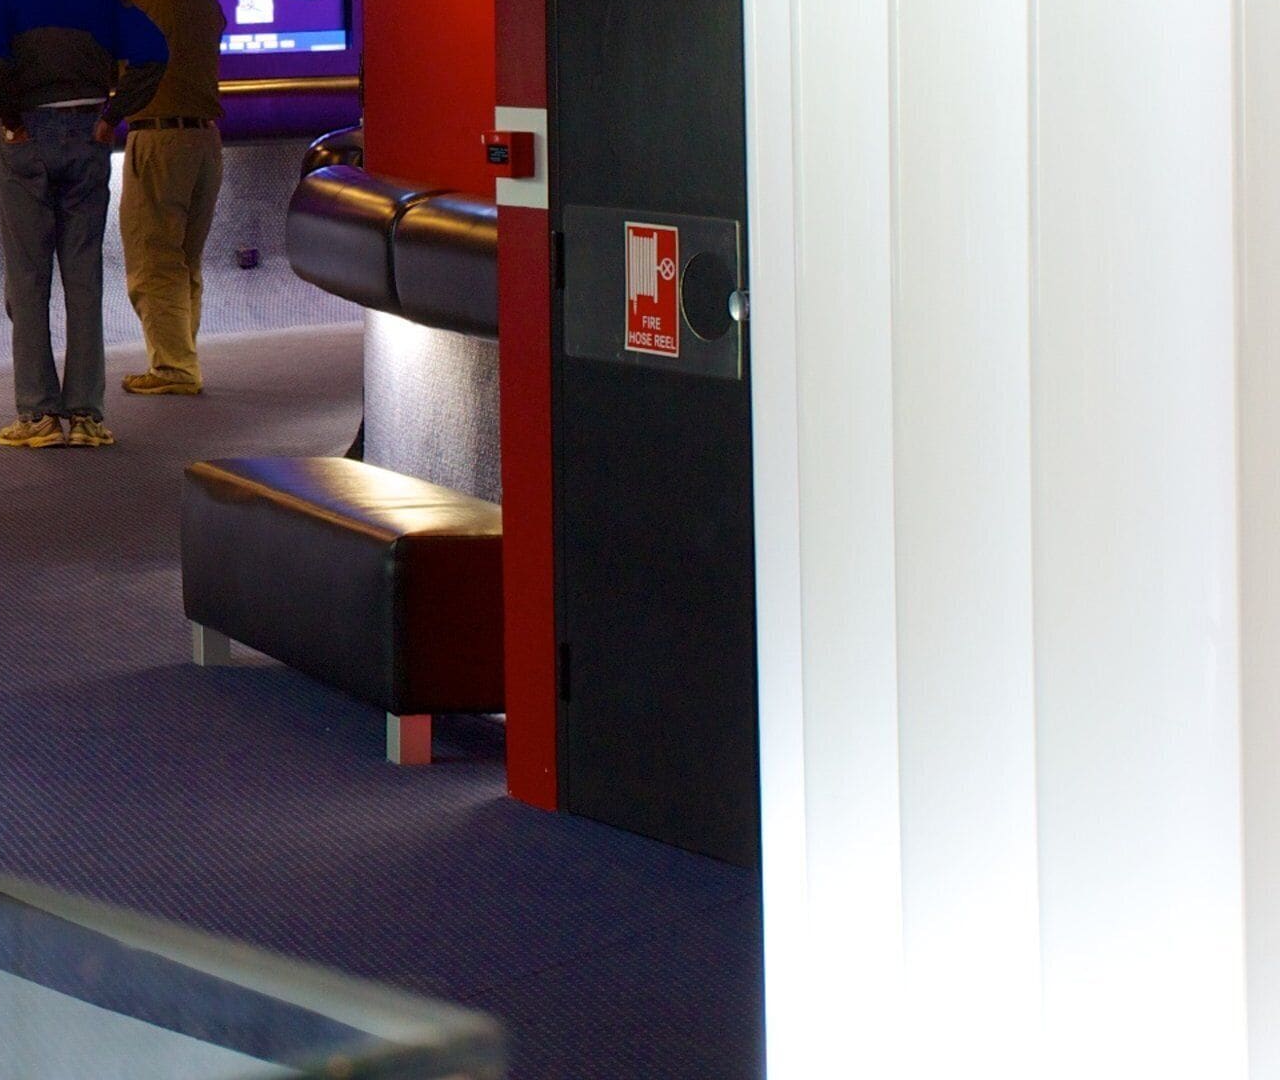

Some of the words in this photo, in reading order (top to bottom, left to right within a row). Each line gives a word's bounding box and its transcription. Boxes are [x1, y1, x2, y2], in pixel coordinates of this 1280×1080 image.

[642, 315, 662, 330] FIRE
[629, 330, 652, 346] HOSE
[654, 334, 676, 350] REEL
